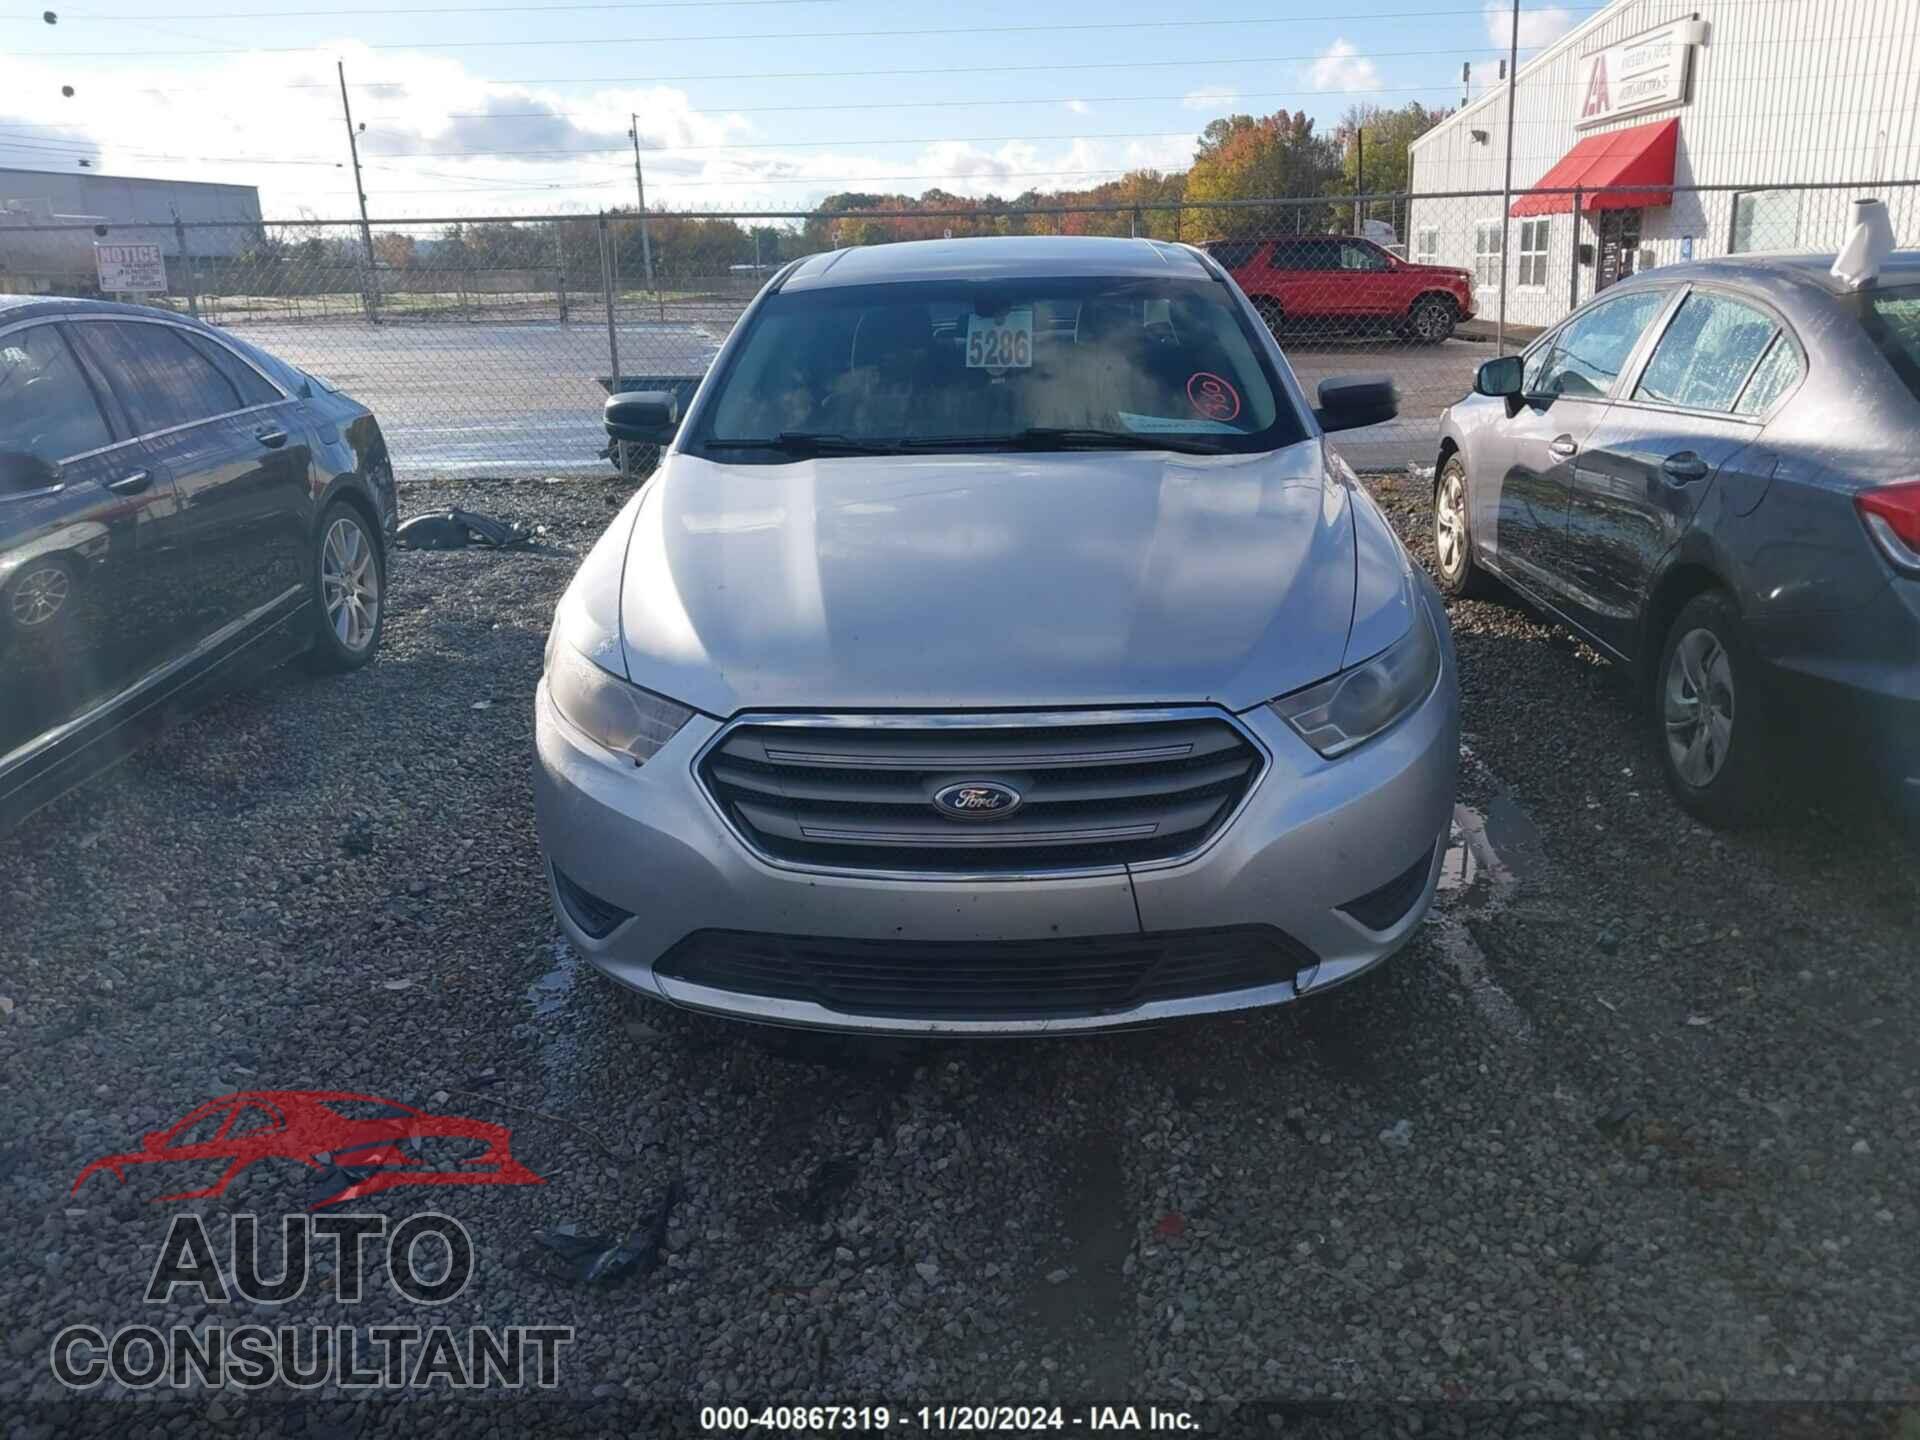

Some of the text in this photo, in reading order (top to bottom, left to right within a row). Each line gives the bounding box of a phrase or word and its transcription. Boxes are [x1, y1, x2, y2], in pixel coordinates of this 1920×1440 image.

[99, 246, 160, 263] NOTICE
[969, 329, 1030, 365] 5286
[954, 788, 1000, 808] Ford
